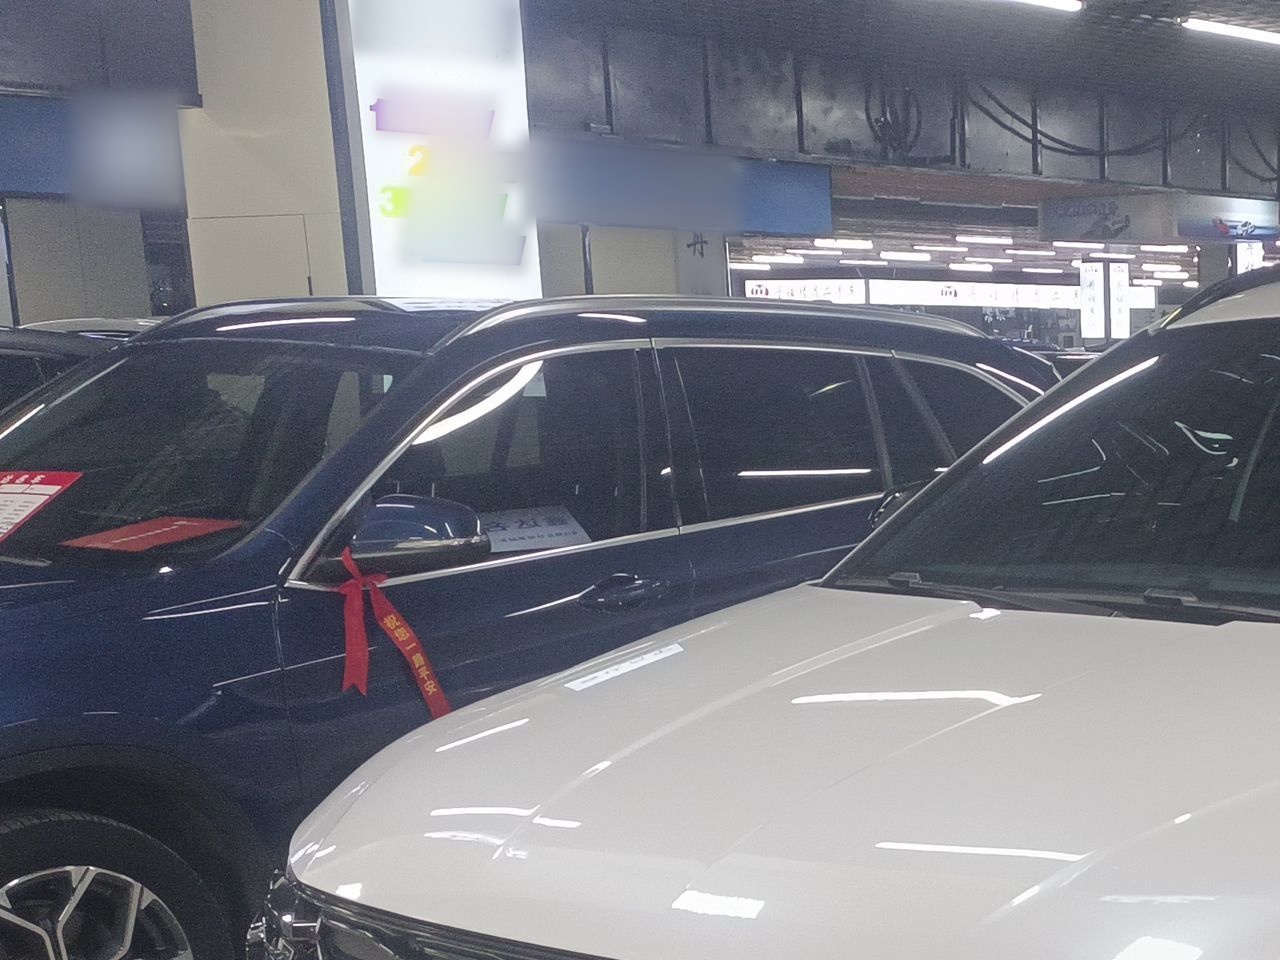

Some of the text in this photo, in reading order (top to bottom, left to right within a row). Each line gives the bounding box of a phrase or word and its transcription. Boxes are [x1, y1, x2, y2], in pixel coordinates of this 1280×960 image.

[408, 144, 430, 177] 2
[384, 614, 438, 696] 祝您一路平安
